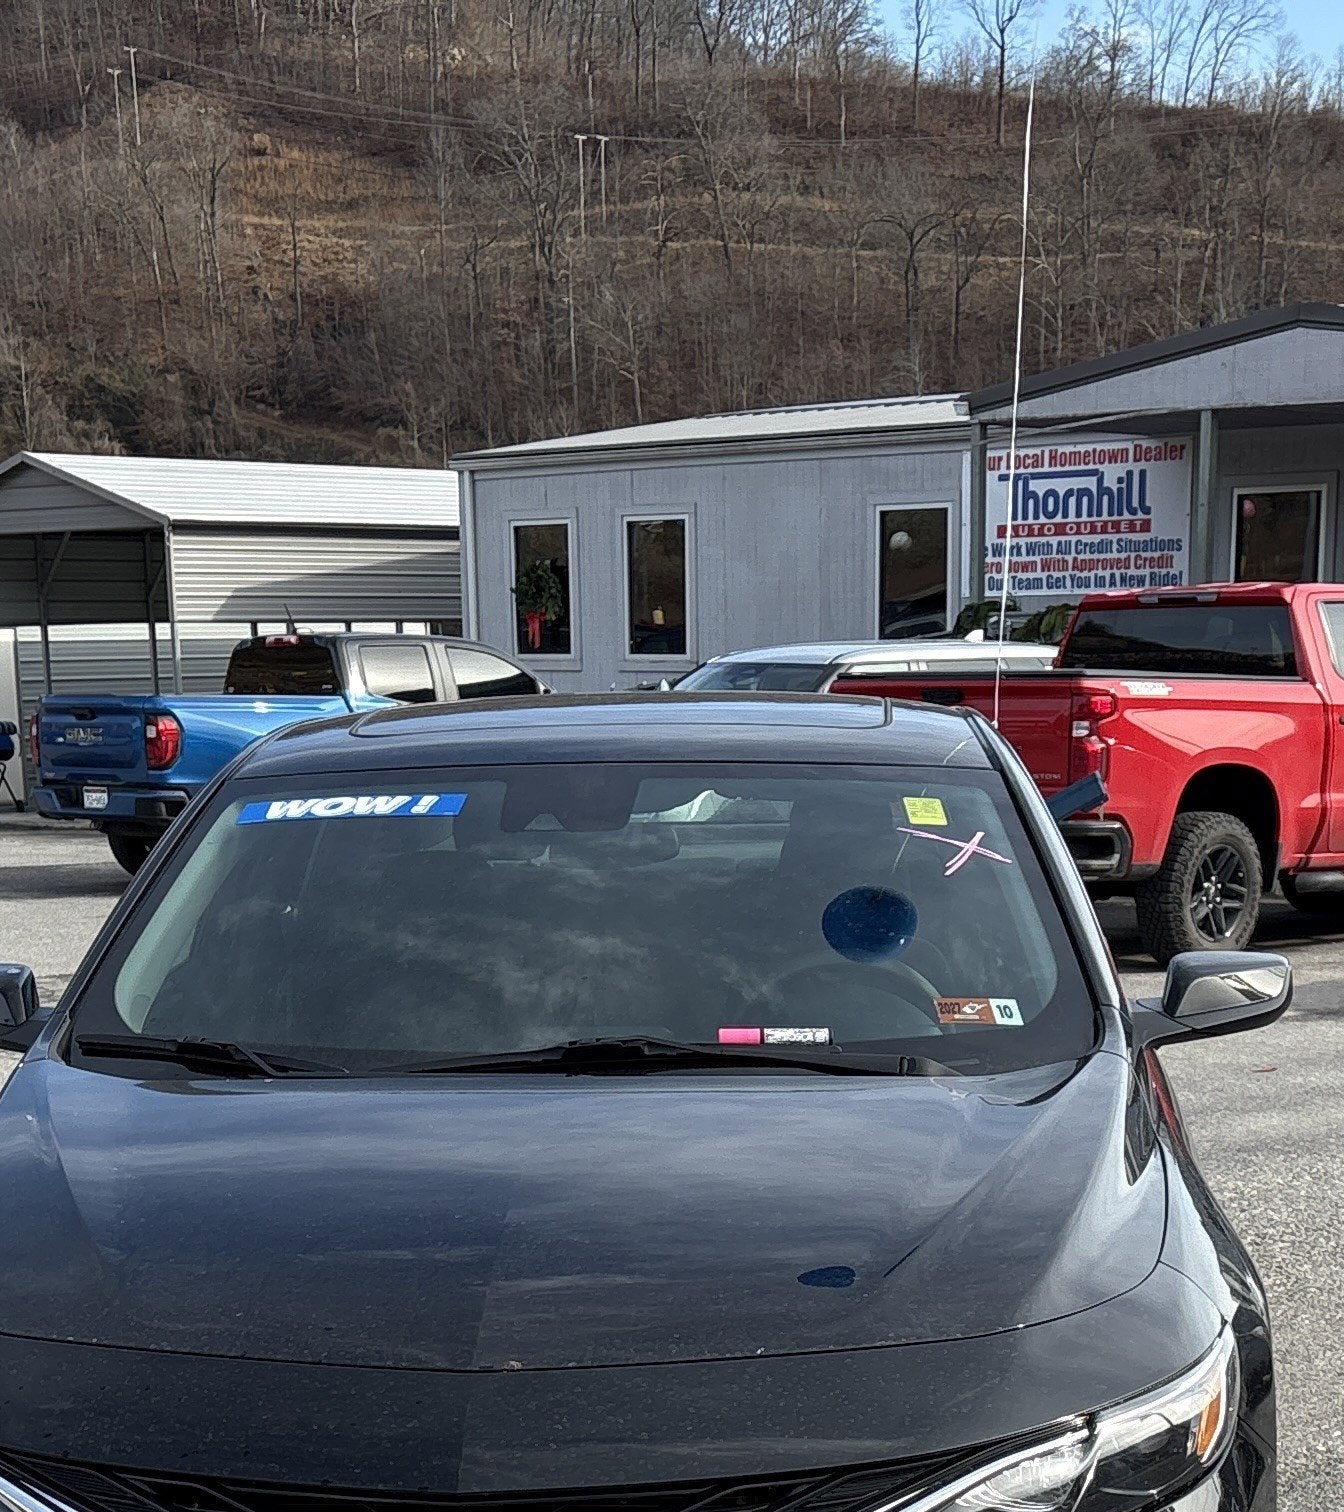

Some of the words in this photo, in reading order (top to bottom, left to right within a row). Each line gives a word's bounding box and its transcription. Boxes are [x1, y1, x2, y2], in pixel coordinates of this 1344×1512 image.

[987, 455, 1004, 472] ur
[1048, 447, 1130, 469] Hometown
[1133, 442, 1187, 463] Dealer
[997, 468, 1152, 522] Thornhill
[1065, 520, 1144, 534] OUTLET
[991, 541, 1023, 558] Wrk
[1025, 540, 1054, 557] With
[1055, 540, 1073, 556] All
[1074, 538, 1114, 555] Credit
[1116, 536, 1184, 554] Situations
[1040, 556, 1070, 573] With
[1071, 554, 1132, 573] Approved
[1134, 553, 1175, 570] Credit
[987, 575, 1004, 592] Ou
[1010, 575, 1044, 591] Team
[1045, 574, 1068, 590] Get
[1069, 573, 1092, 589] You
[1093, 572, 1107, 588] In
[1108, 572, 1117, 588] A
[1119, 571, 1147, 588] New
[1149, 570, 1184, 587] Ride!
[996, 1004, 1014, 1019] 10
